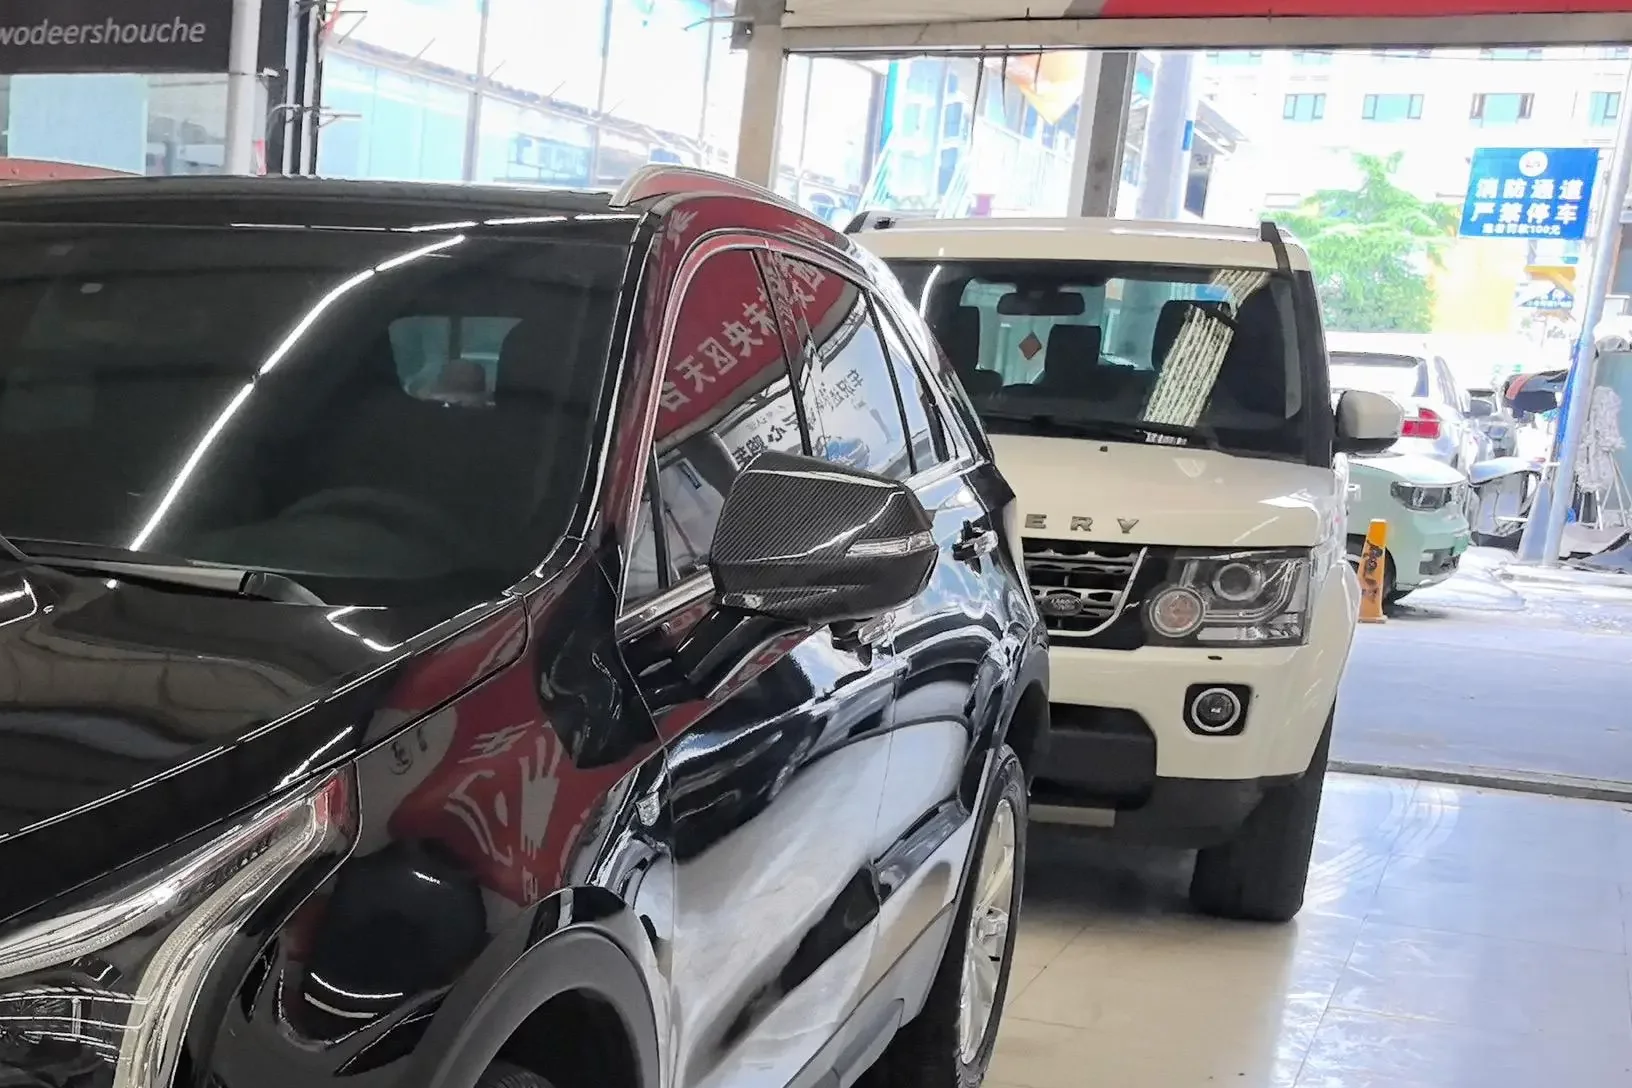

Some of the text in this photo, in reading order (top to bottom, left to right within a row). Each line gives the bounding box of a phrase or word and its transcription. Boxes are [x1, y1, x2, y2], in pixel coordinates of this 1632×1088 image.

[1475, 177, 1584, 200] 消防通道
[1470, 202, 1578, 225] 严禁停车
[1024, 513, 1140, 534] ERY
